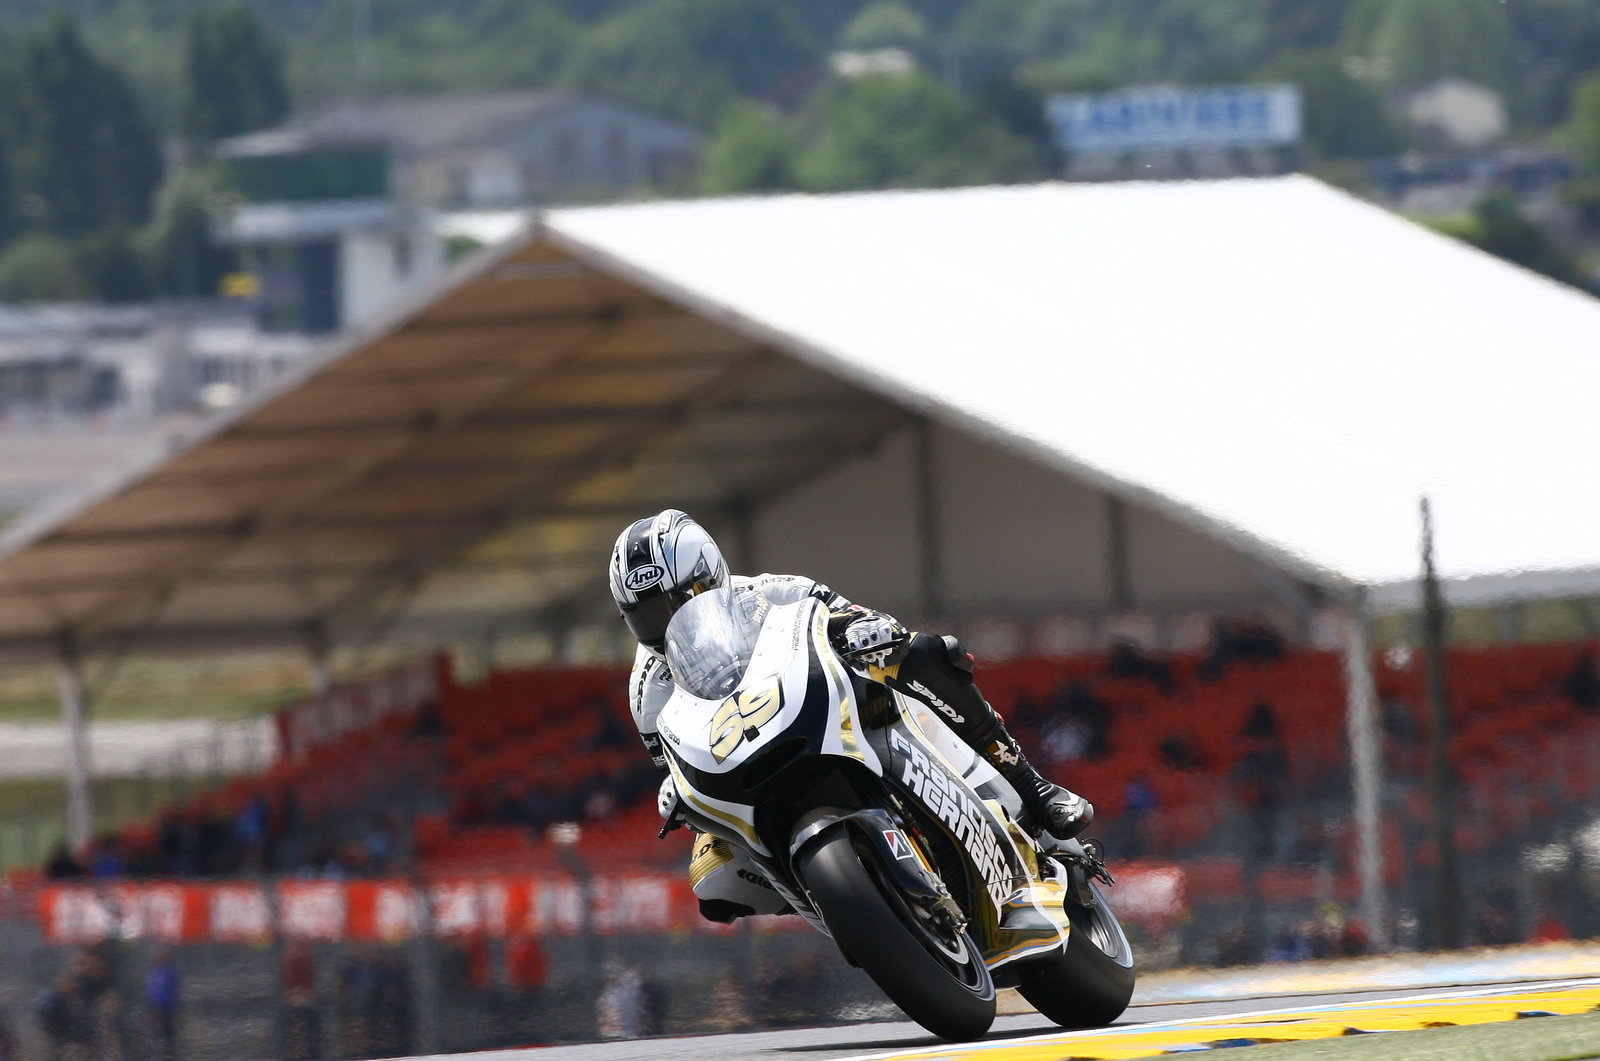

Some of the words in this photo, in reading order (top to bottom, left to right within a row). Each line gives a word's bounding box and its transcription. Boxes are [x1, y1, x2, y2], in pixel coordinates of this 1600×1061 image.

[627, 566, 659, 588] Arai
[709, 672, 785, 765] 59
[906, 680, 965, 723] SPIDI
